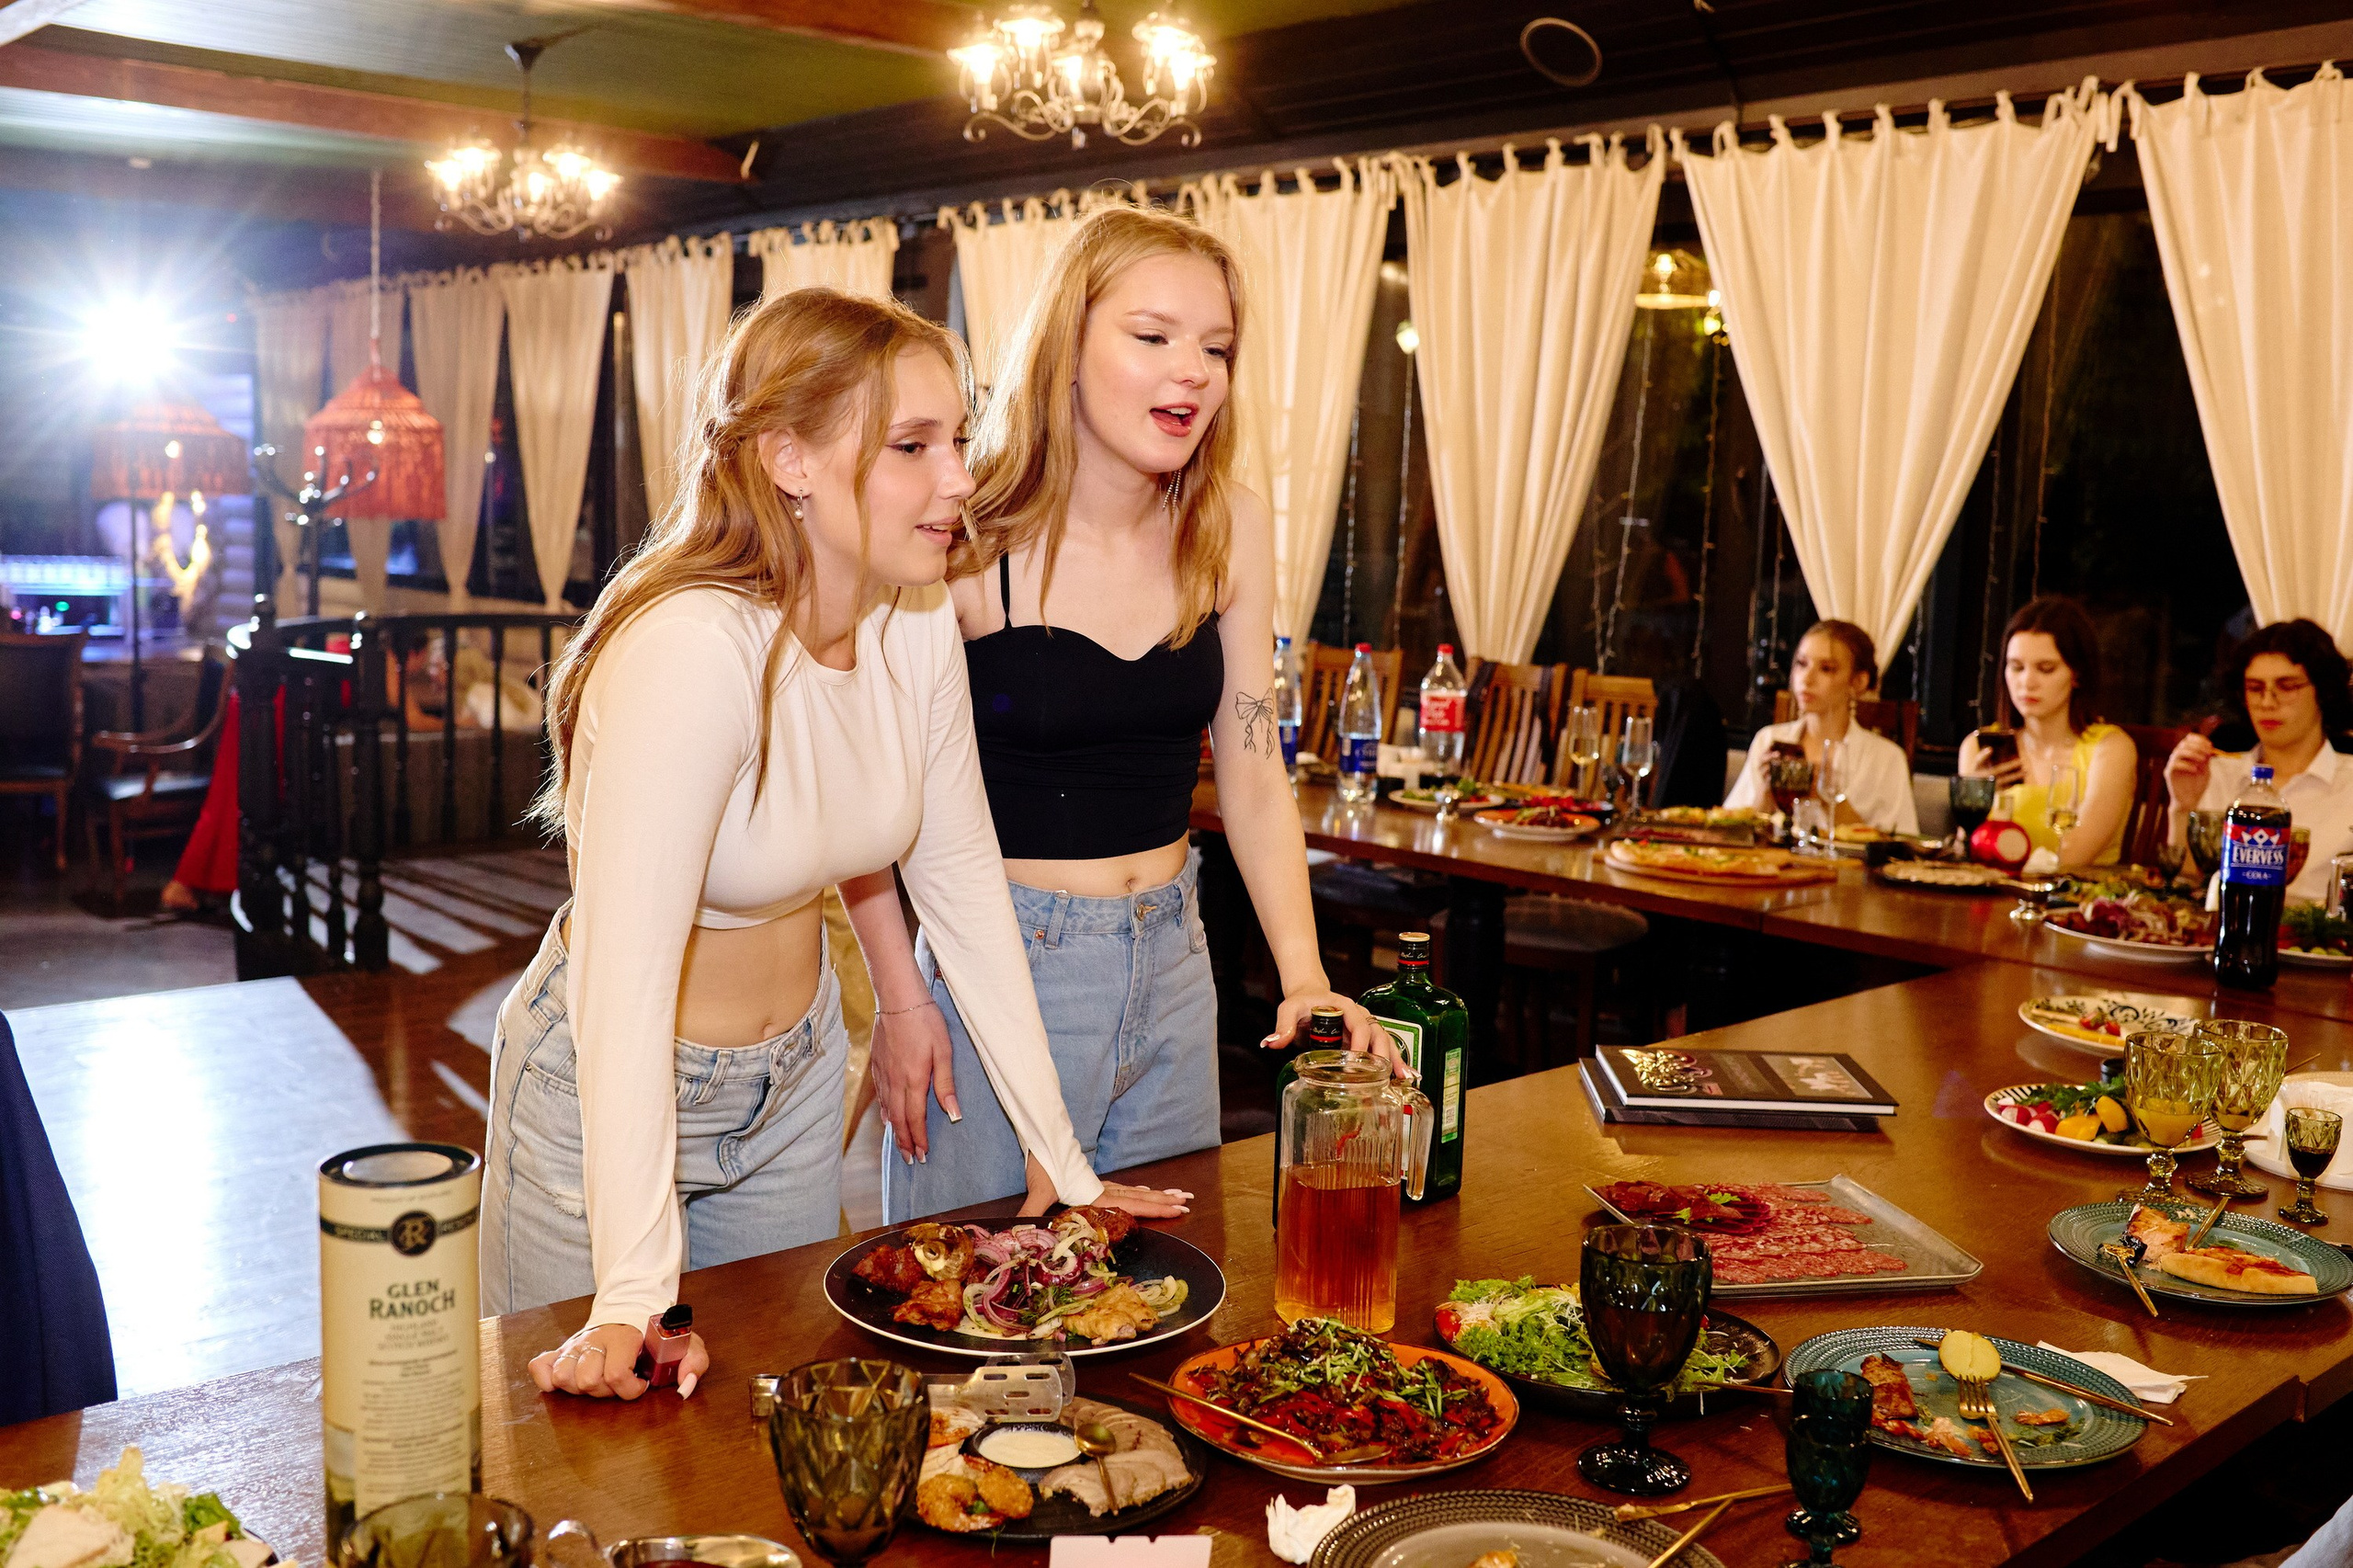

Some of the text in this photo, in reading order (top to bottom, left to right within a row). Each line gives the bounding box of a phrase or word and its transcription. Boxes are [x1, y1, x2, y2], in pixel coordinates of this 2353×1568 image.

[2233, 846, 2284, 865] EVERVESS
[2245, 870, 2268, 881] COLA
[387, 1278, 439, 1299] GLEN
[369, 1288, 456, 1319] RANOCH
